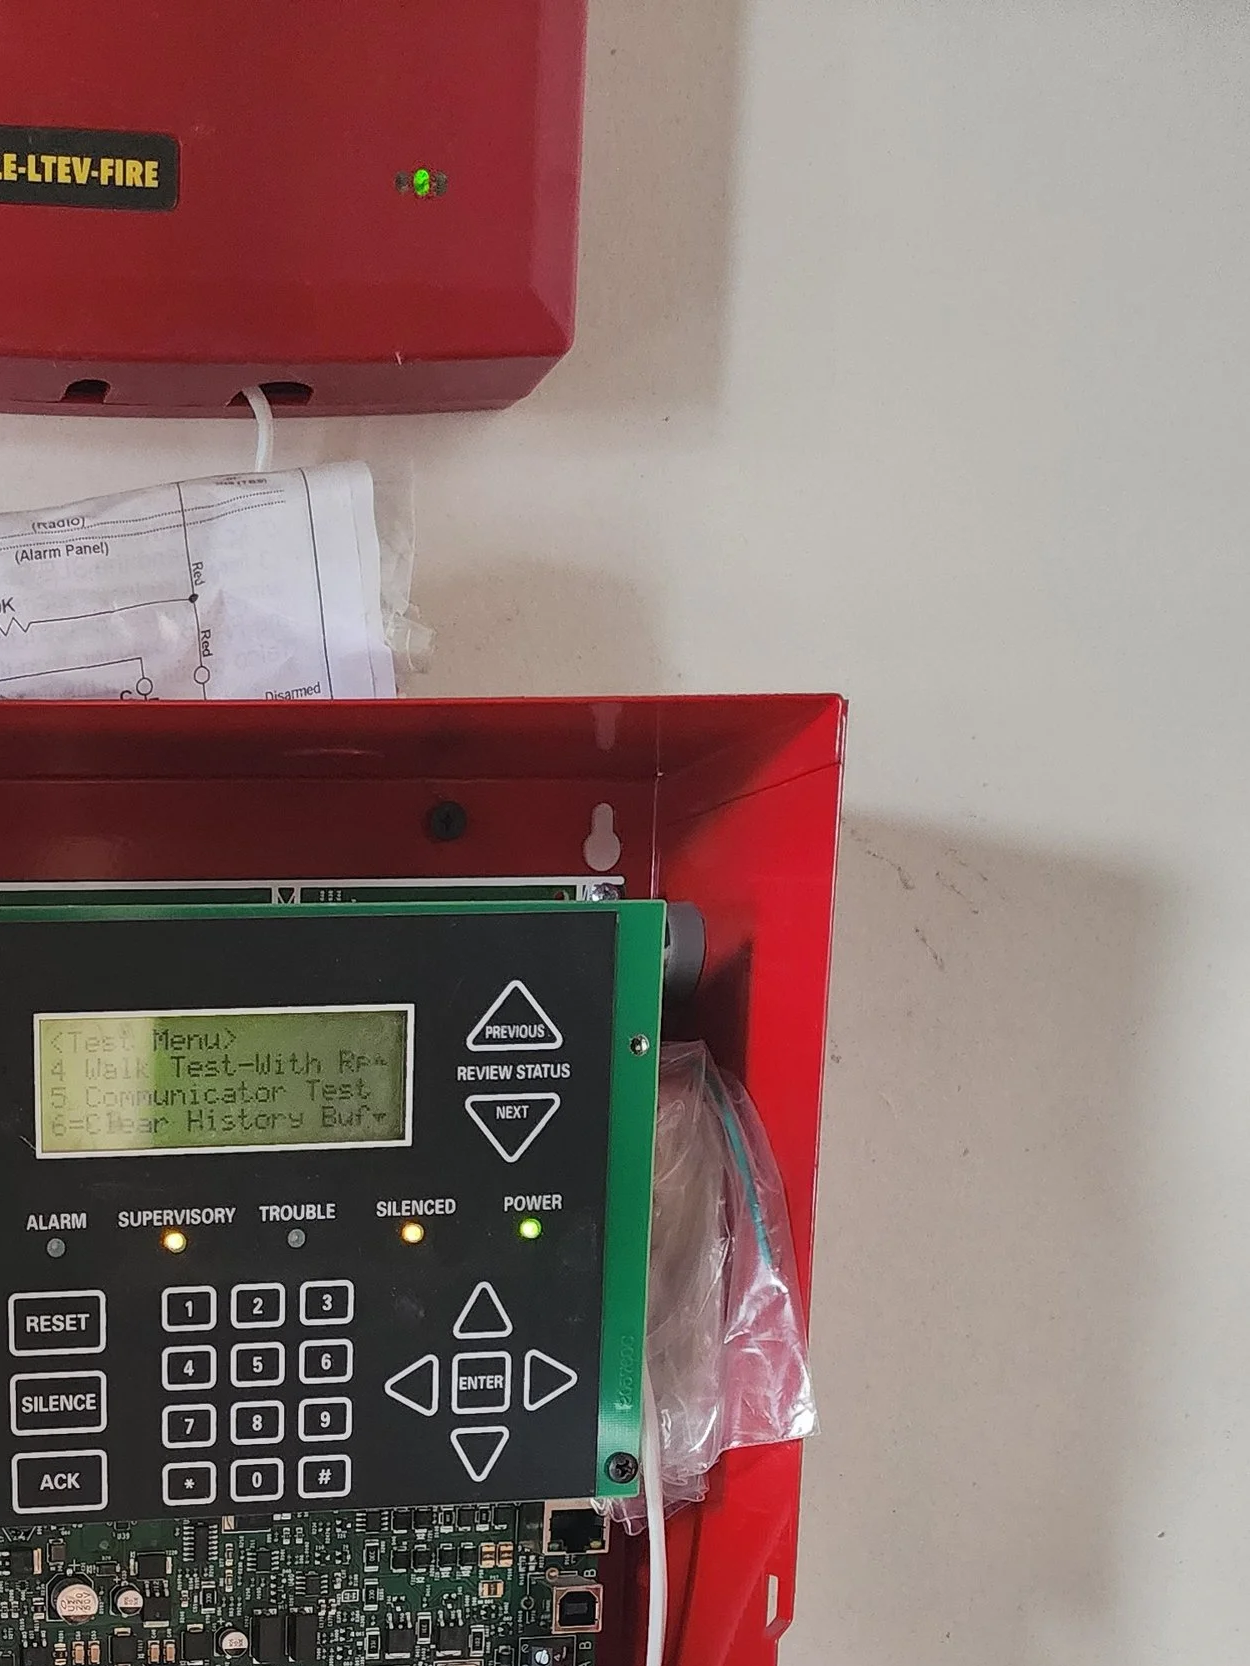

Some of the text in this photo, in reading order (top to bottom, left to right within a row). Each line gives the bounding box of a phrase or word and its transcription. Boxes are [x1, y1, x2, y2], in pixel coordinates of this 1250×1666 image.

[15, 541, 110, 565] (Alarm Panel)
[193, 561, 206, 586] Red
[200, 629, 213, 657] Red
[265, 681, 321, 700] Disarmed
[485, 1024, 545, 1039] PREVIOUS
[85, 1057, 150, 1079] Walk
[170, 1052, 323, 1078] Test-With
[457, 1063, 571, 1081] REVIEW STATUS
[85, 1081, 287, 1109] Communicator
[305, 1077, 371, 1102] Test
[186, 1108, 304, 1133] History
[496, 1105, 529, 1119] NEXT
[376, 1198, 456, 1217] SILENCED
[503, 1194, 563, 1212] POWER
[26, 1212, 88, 1232] ALARM
[117, 1207, 236, 1228] SUPERVISORY
[259, 1203, 336, 1223] TROUBLE
[184, 1300, 193, 1318] 1
[252, 1297, 263, 1315] 2
[321, 1294, 332, 1312] 3
[25, 1313, 90, 1334] RESET
[183, 1360, 195, 1378] 4
[252, 1356, 263, 1374] 5
[320, 1353, 332, 1371] 6
[459, 1374, 503, 1392] ENTER
[21, 1392, 97, 1414] SILENCE
[184, 1418, 195, 1435] 7
[251, 1415, 263, 1432] 8
[319, 1411, 331, 1429] 9
[39, 1472, 81, 1492] ACK
[251, 1472, 262, 1489] 0
[318, 1469, 331, 1486] #
